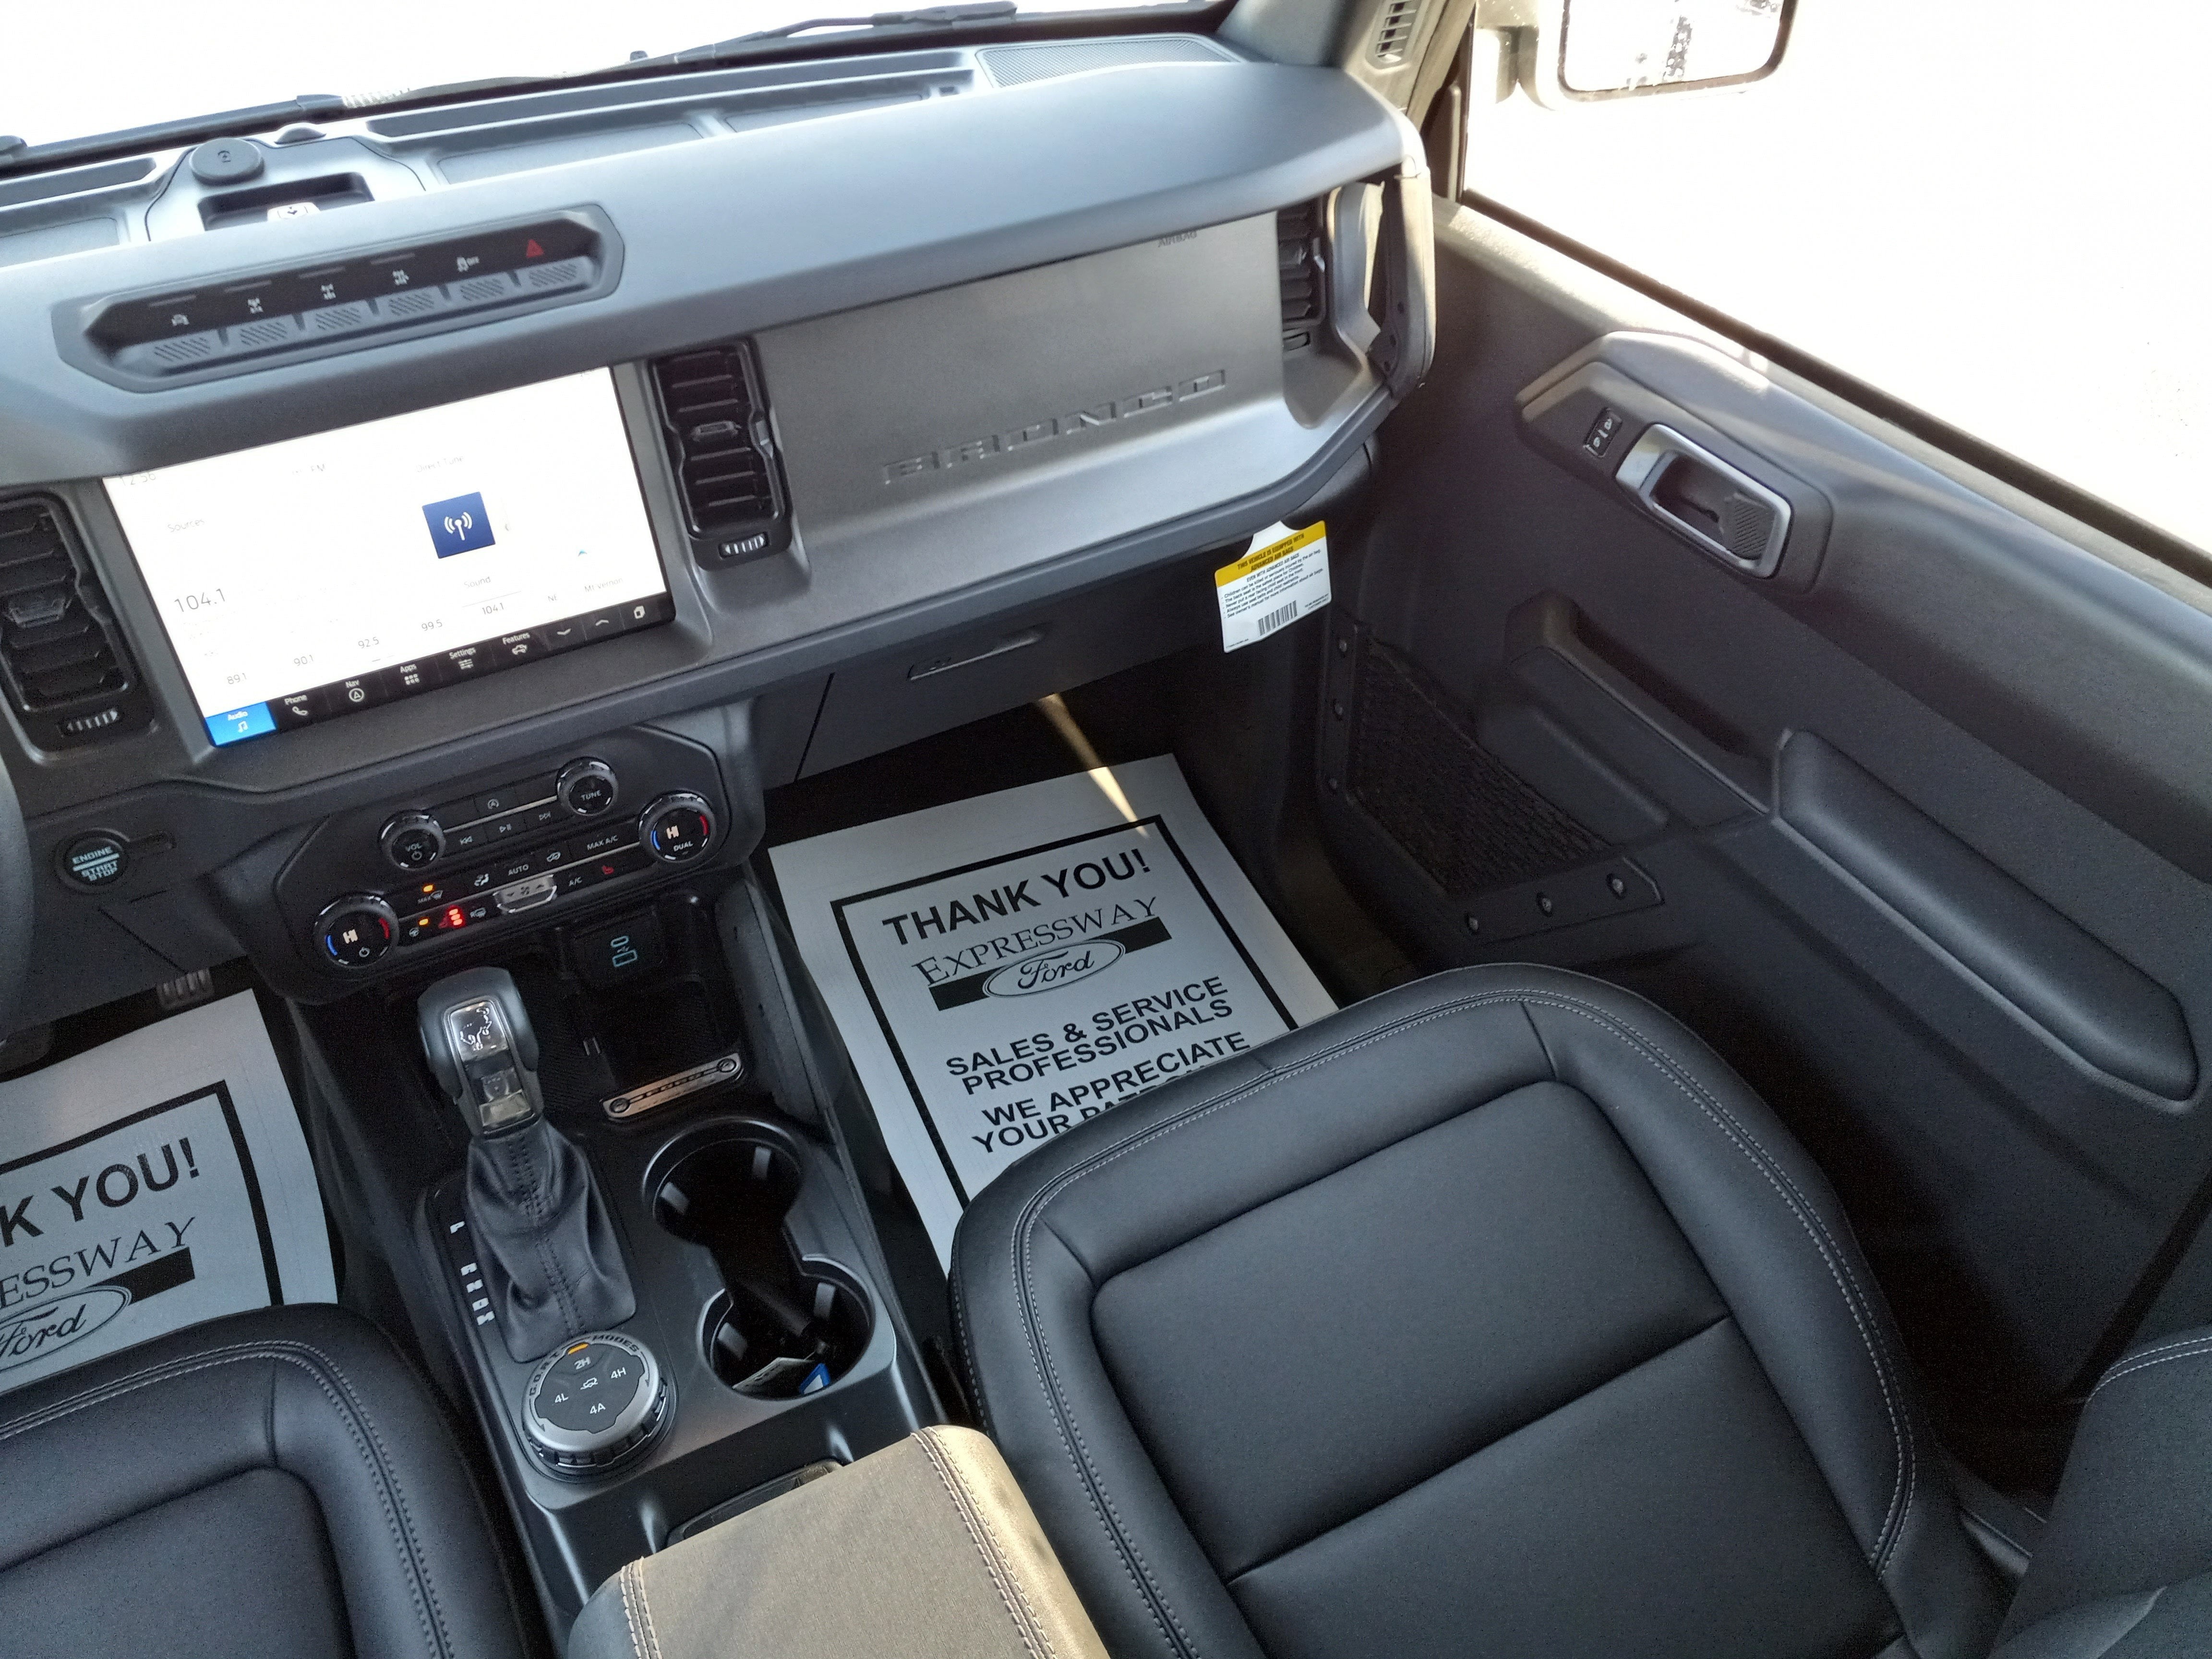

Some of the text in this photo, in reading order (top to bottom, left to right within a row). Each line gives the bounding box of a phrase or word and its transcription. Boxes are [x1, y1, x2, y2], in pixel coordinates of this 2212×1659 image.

[883, 369, 1226, 484] BRONCO
[1238, 560, 1248, 570] THIS
[1248, 551, 1266, 564] VEHICLE
[1272, 539, 1293, 553] EQUIPPED
[1293, 533, 1304, 543] WITH
[1250, 556, 1274, 573] ADVANCED
[1282, 545, 1294, 557] BAGS
[464, 576, 491, 588] Sound
[174, 588, 226, 613] 104.1
[421, 619, 443, 631] 99.5
[358, 637, 379, 649] 92.5
[503, 632, 530, 645] Features
[449, 648, 476, 660] Settings
[400, 663, 417, 673] Apps
[346, 679, 360, 688] Nav
[285, 695, 308, 705] Phone
[228, 710, 248, 721] Audio
[581, 790, 602, 801] TUNE
[405, 842, 422, 852] VOL
[587, 834, 619, 850] MAX A/C
[673, 840, 694, 852] DUAL
[72, 846, 113, 864] ENGINE
[508, 864, 529, 876] AUTO
[568, 876, 583, 887] A/C
[417, 896, 432, 904] MAX
[882, 848, 1151, 946] THANK YOU!
[912, 896, 1156, 987] EXPRESSWAY
[1017, 950, 1095, 990] Ford
[945, 976, 1228, 1076] SALES & SERVICE
[962, 999, 1233, 1095] PROFESSIONALS
[981, 1098, 1042, 1126] WE
[1050, 1032, 1250, 1112] APPRECIATE
[972, 1114, 1072, 1154] YOUR
[50, 1137, 200, 1223] YOU!
[450, 1221, 465, 1234] P
[460, 1262, 478, 1276] R
[466, 1279, 484, 1293] N
[472, 1297, 489, 1312] D
[476, 1310, 495, 1326] M
[592, 1334, 639, 1353] MODES
[574, 1357, 592, 1370] 2H
[610, 1367, 627, 1379] 4H
[554, 1393, 569, 1404] 4L
[589, 1402, 606, 1415] 4A
